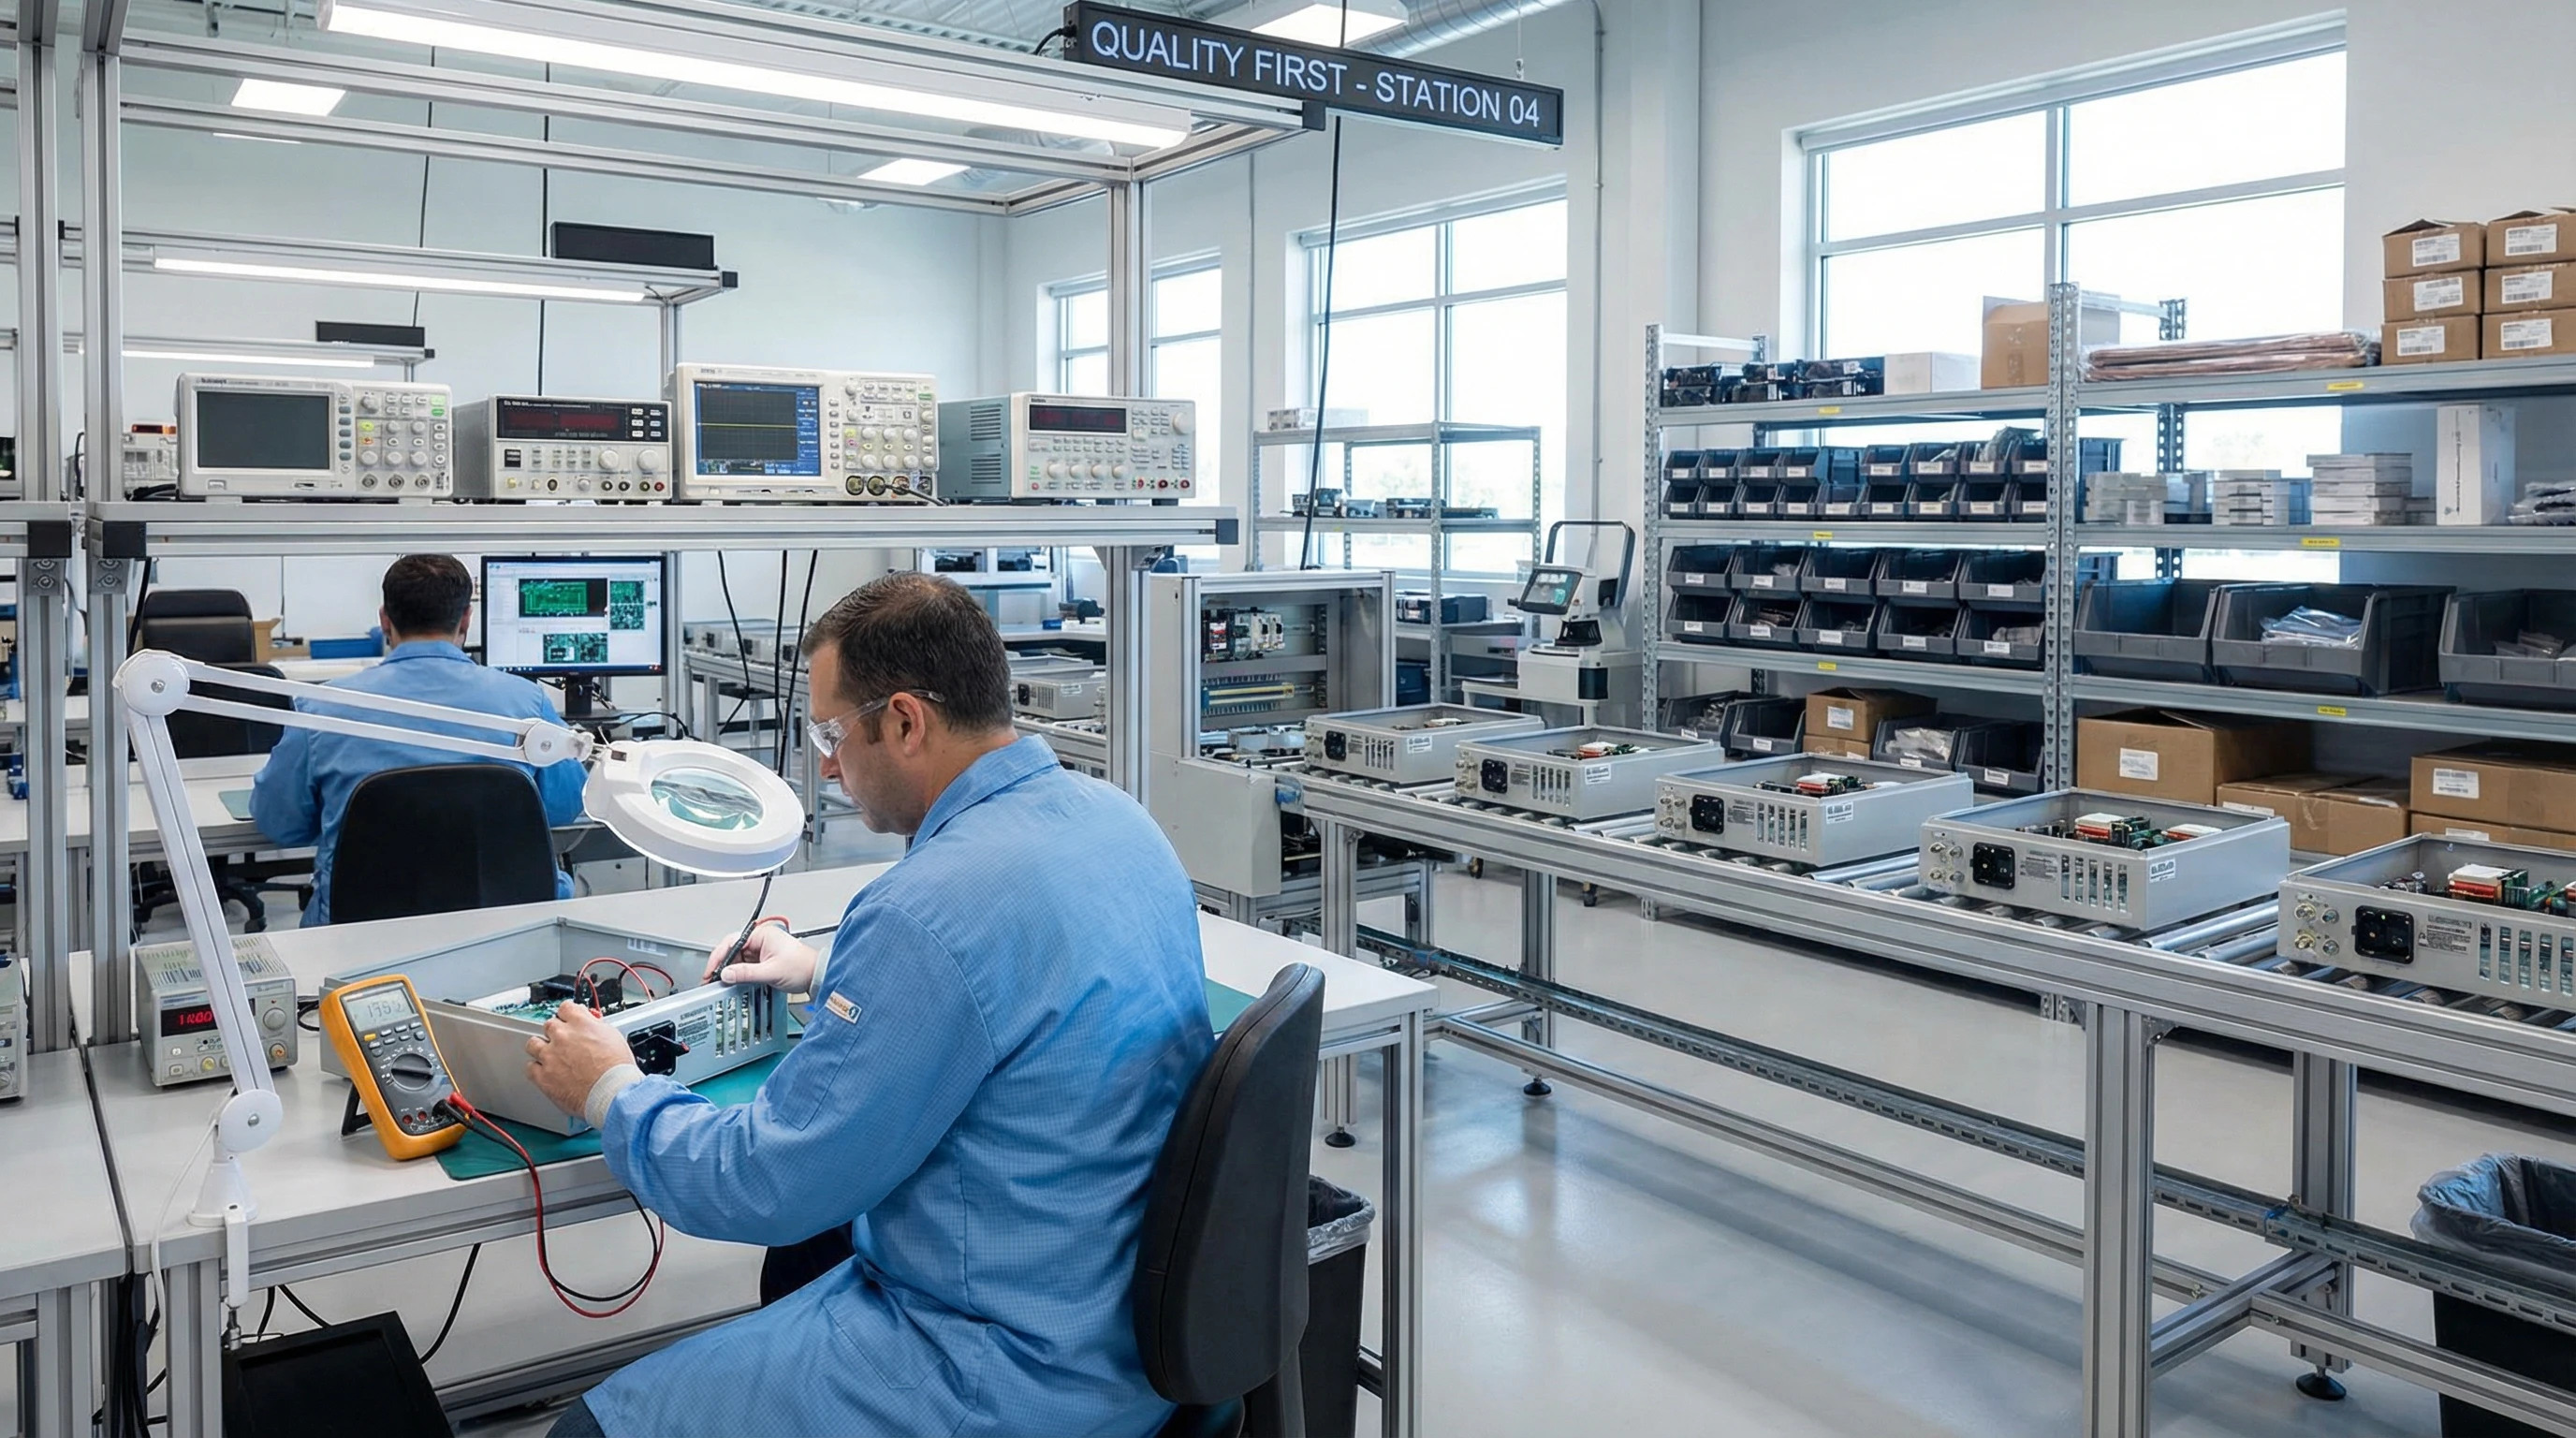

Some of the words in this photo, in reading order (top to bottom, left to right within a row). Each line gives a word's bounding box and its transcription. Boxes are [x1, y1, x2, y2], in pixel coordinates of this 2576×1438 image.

[1091, 21, 1245, 78] QUALITY
[1254, 50, 1348, 95] FIRST
[1375, 71, 1500, 122] STATION
[1509, 95, 1541, 128] 04
